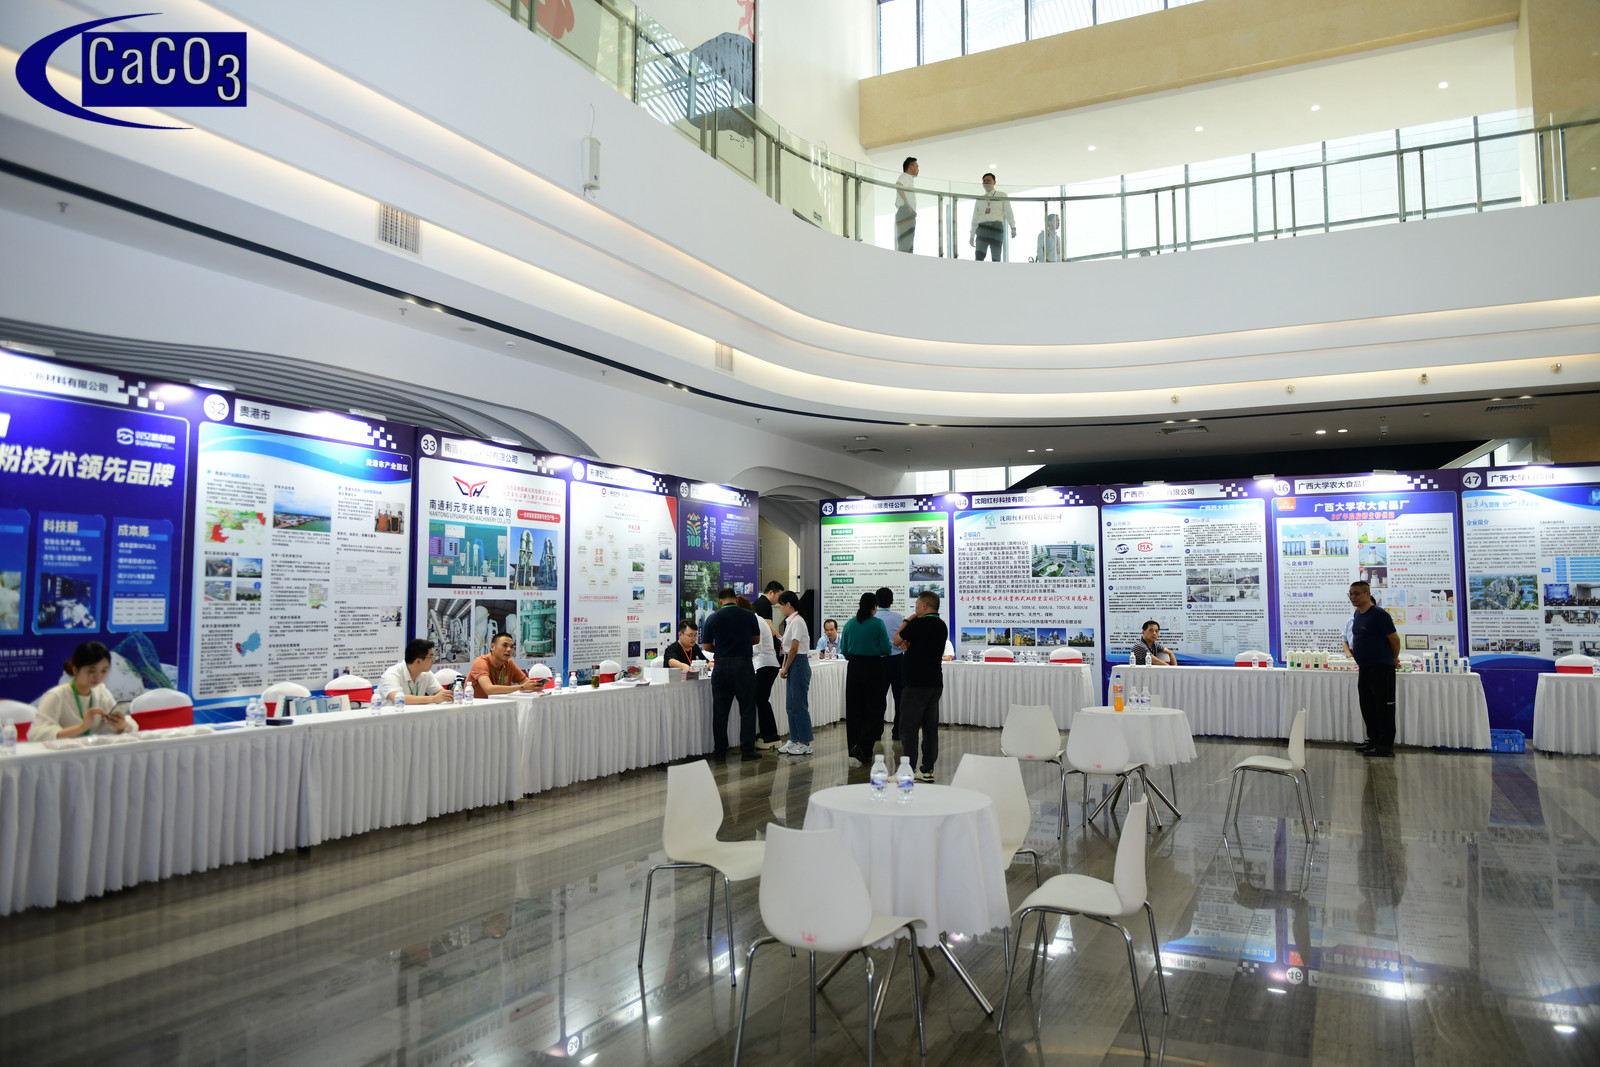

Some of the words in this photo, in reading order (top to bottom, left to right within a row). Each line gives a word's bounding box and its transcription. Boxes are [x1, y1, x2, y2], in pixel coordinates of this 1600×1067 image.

[207, 400, 226, 416] 32
[239, 405, 271, 421] 贵港市
[422, 438, 437, 452] 33
[1464, 475, 1480, 485] 47
[680, 485, 689, 494] 35
[1275, 483, 1289, 492] 46
[1103, 492, 1116, 501] 45
[1123, 488, 1195, 499] 广西西大有限公司
[429, 499, 512, 518] 南通利元亨机械有限公司
[822, 505, 833, 513] 43
[1314, 500, 1410, 513] 广西大学农大食品厂
[686, 535, 701, 547] 100
